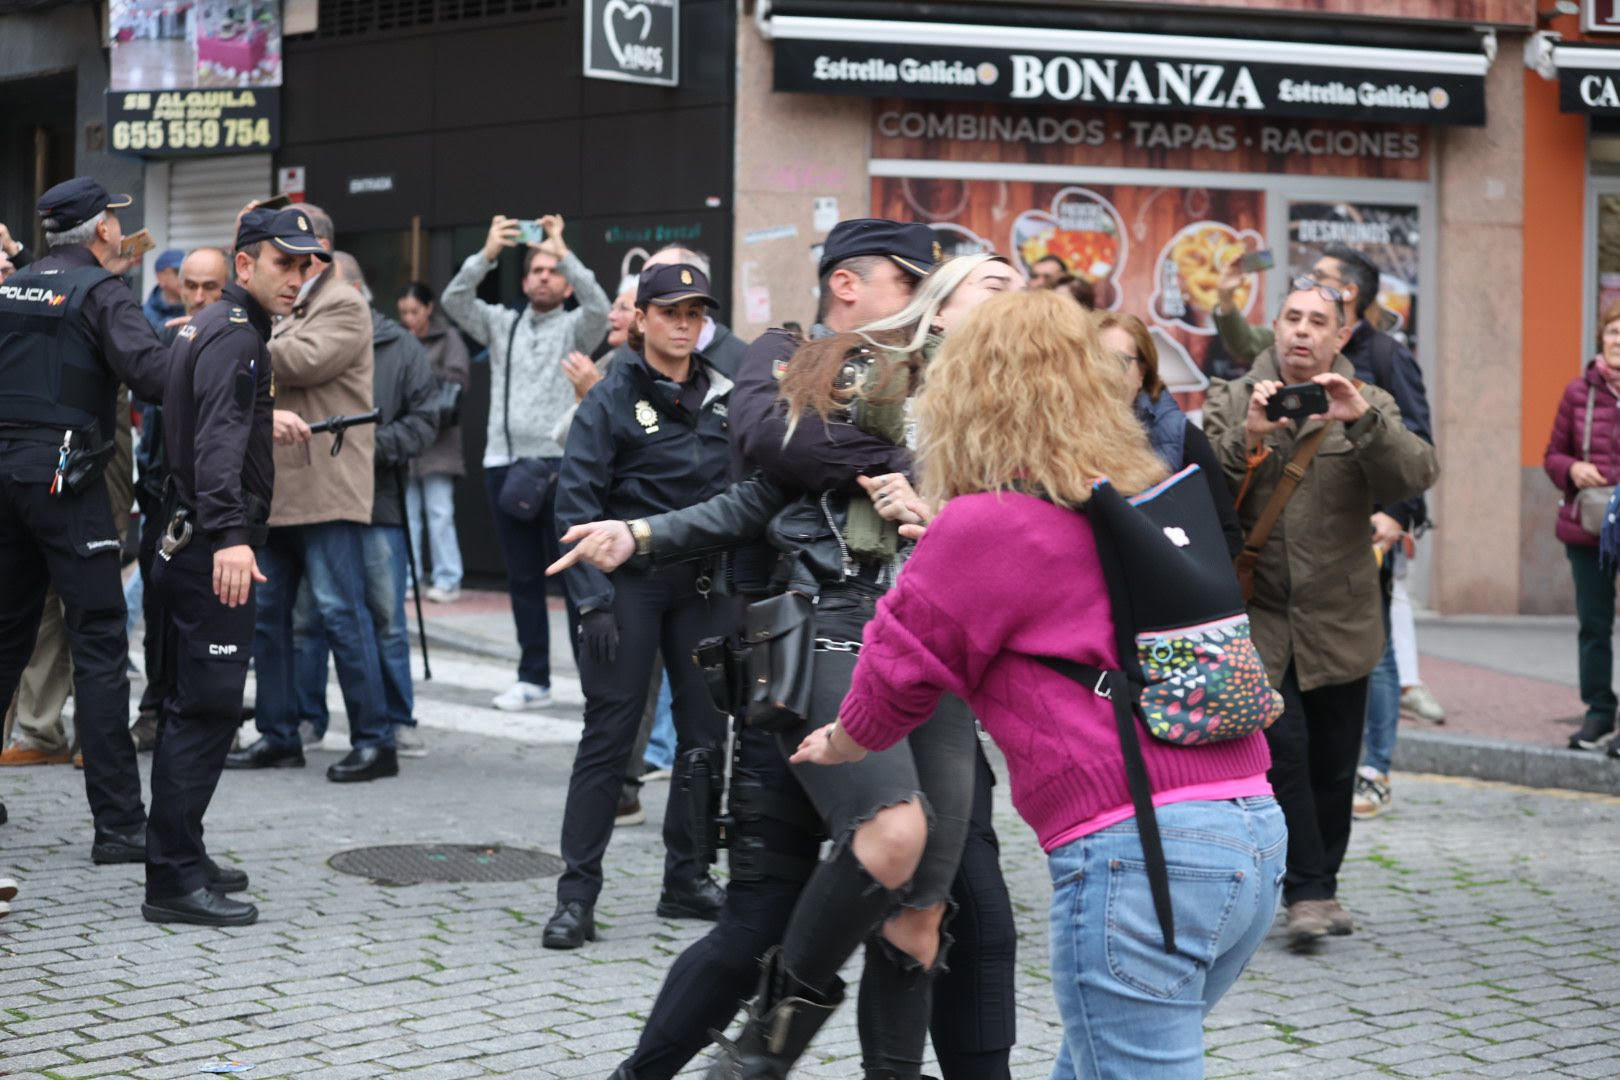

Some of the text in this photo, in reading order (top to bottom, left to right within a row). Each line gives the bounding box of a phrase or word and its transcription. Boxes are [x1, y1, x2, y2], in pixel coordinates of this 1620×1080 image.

[813, 56, 977, 85] Estrella Galicia
[1009, 55, 1265, 110] BONANZA
[155, 90, 256, 109] ALQUILA
[1278, 78, 1430, 109] Estrella Galicia
[112, 117, 271, 150] 655 559 754
[878, 111, 1420, 158] COMBINADOS TAPAS RACIONES
[0, 285, 54, 303] POLICIA
[209, 643, 238, 655] CNP
